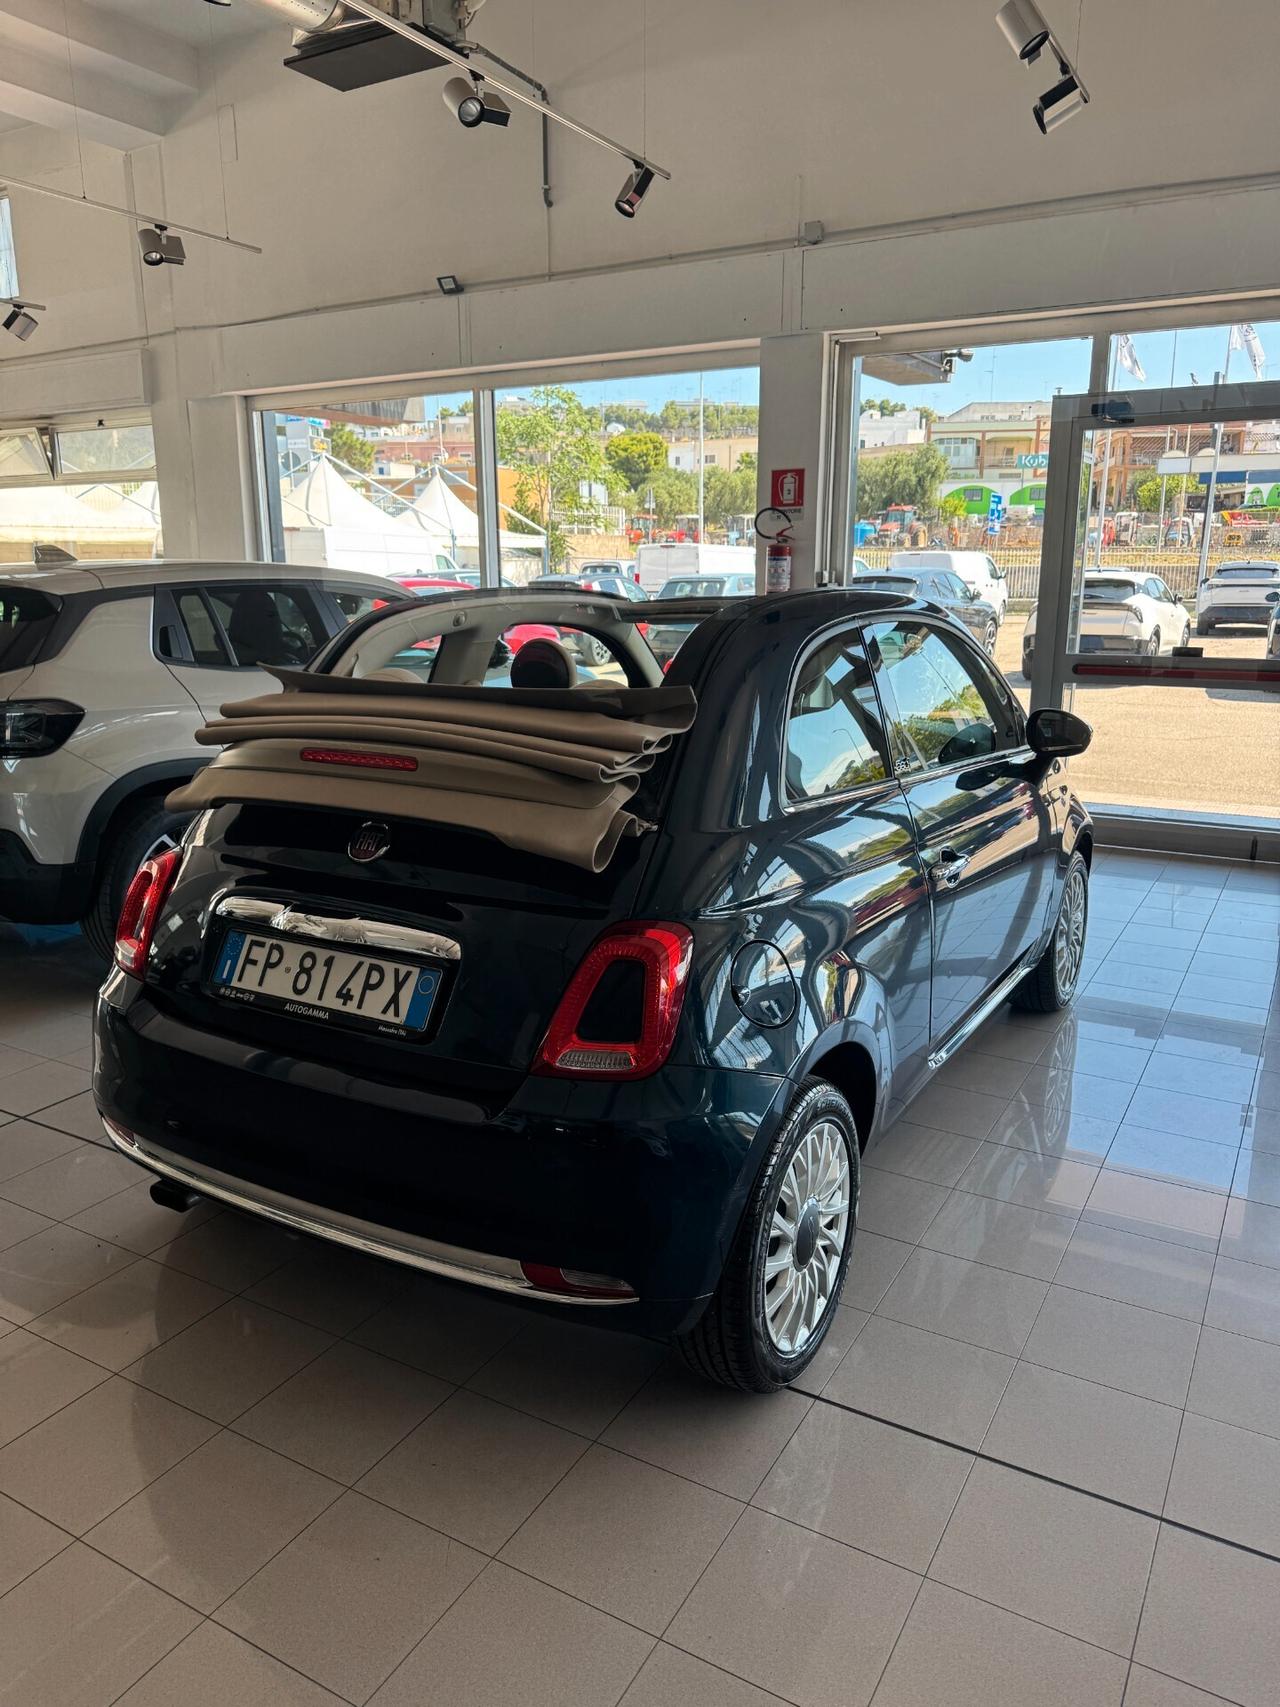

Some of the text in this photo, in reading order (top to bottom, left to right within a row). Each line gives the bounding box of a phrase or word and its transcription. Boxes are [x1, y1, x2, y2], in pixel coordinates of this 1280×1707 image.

[237, 939, 413, 1018] FP 814PX
[284, 1002, 329, 1020] AUTOGAMMA
